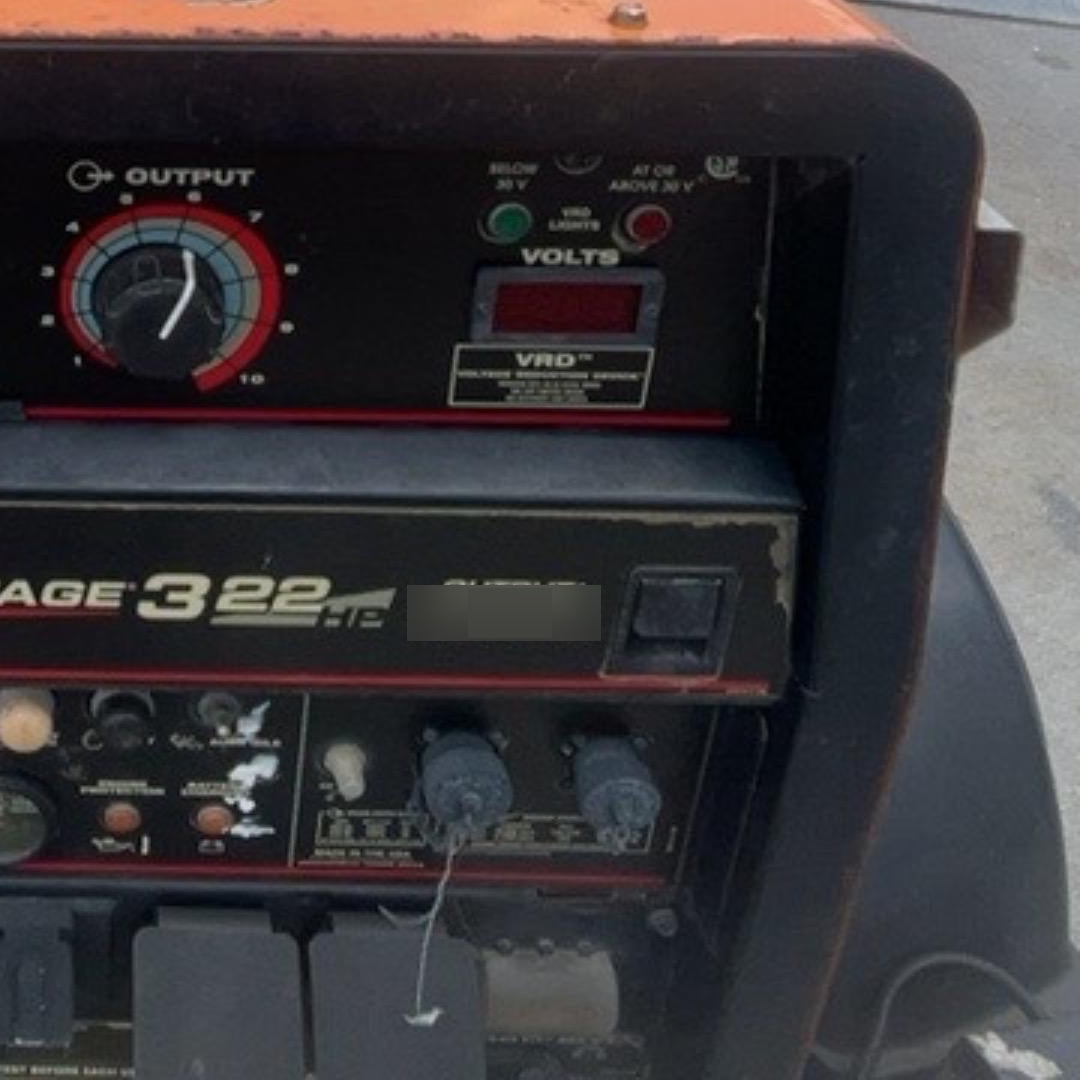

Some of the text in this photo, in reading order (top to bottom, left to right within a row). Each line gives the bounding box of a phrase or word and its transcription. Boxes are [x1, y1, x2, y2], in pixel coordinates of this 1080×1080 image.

[125, 167, 255, 187] OUTPUT
[608, 179, 659, 193] ABOVE
[521, 247, 620, 266] VOLTS
[136, 572, 332, 621] 322
